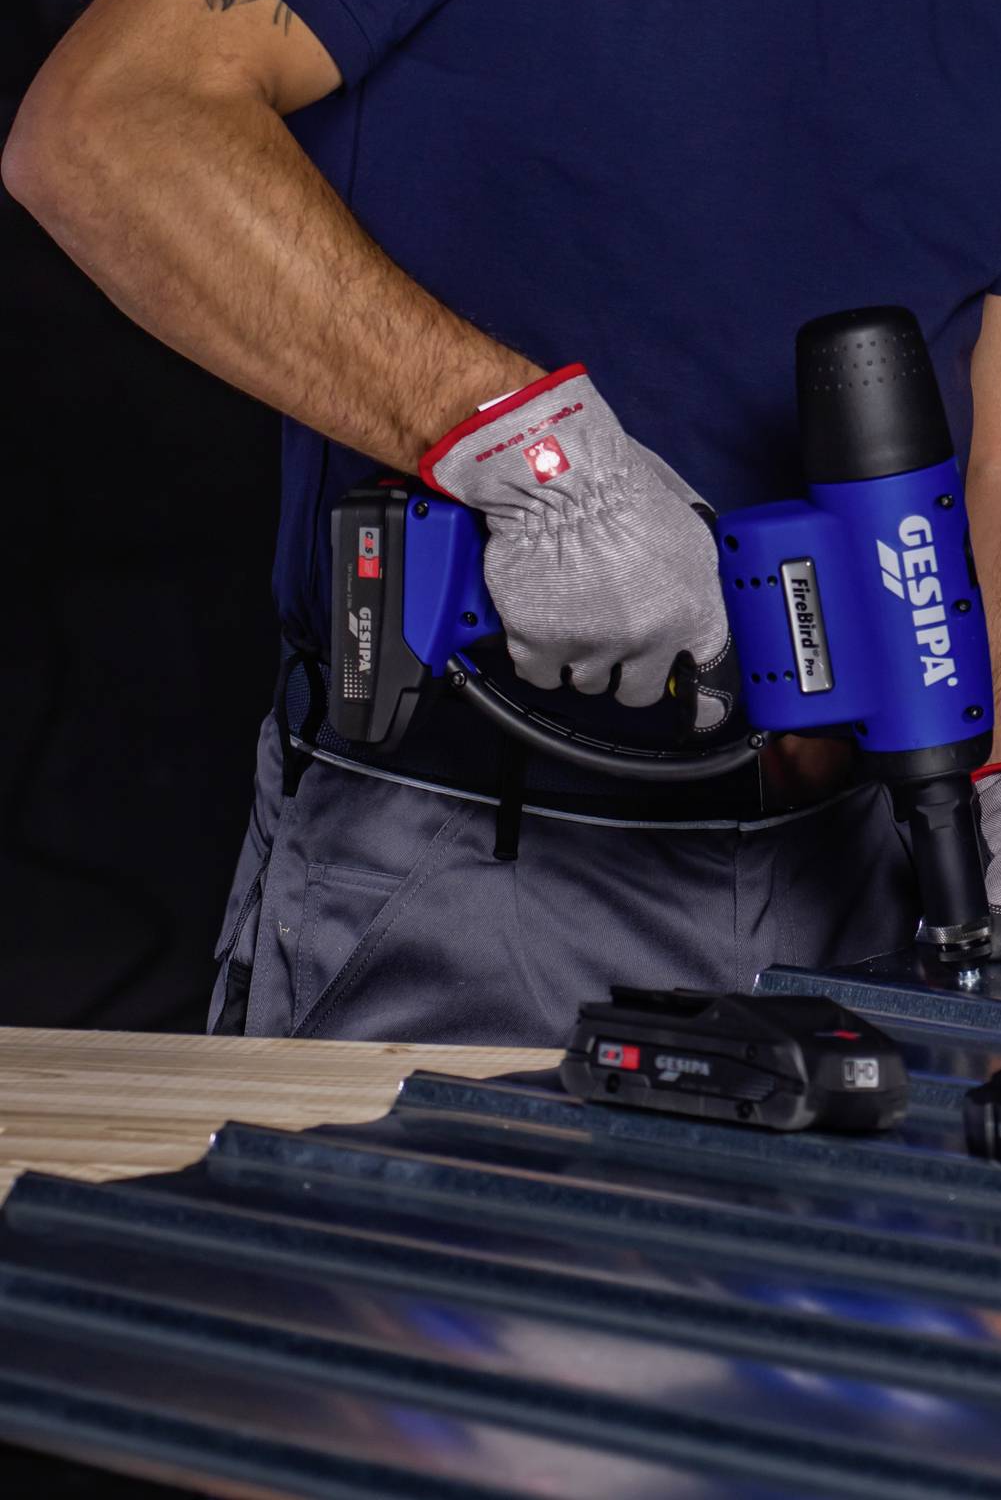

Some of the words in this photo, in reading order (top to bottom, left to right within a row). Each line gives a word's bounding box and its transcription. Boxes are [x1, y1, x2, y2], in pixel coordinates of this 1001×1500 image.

[898, 515, 957, 687] GESIPA
[358, 606, 373, 673] GESIPA
[804, 658, 815, 677] Pro
